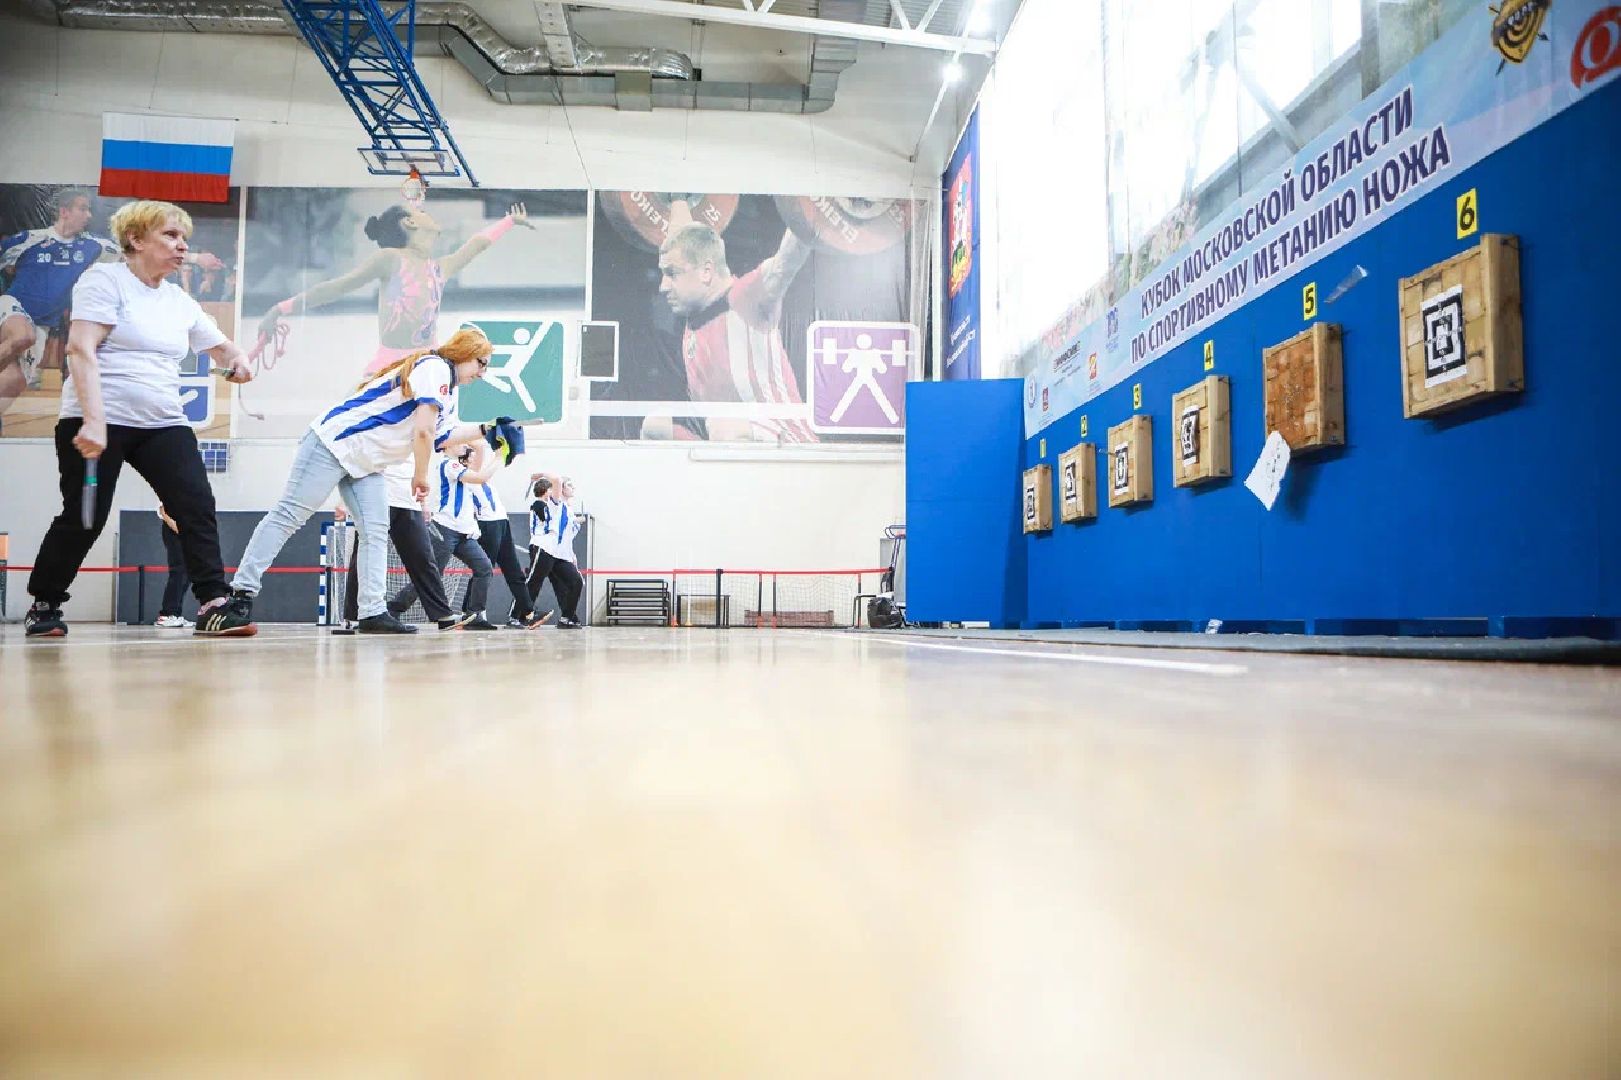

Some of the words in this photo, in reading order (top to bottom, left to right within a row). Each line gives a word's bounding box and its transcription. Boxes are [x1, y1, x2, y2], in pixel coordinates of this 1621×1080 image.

[1141, 265, 1180, 319] КУБОК
[1183, 169, 1295, 286] МОСКОВСКОЙ
[1302, 87, 1413, 201] ОБЛАСТИ
[1460, 197, 1475, 231] 6
[1132, 332, 1146, 364] ПО
[1149, 259, 1248, 350] СПОРТИВНОМУ
[1253, 188, 1357, 284] МЕТАНИЮ
[1363, 125, 1450, 216] НОЖА
[1304, 287, 1314, 315] 5
[1205, 344, 1212, 365] 4
[1133, 386, 1140, 406] 3
